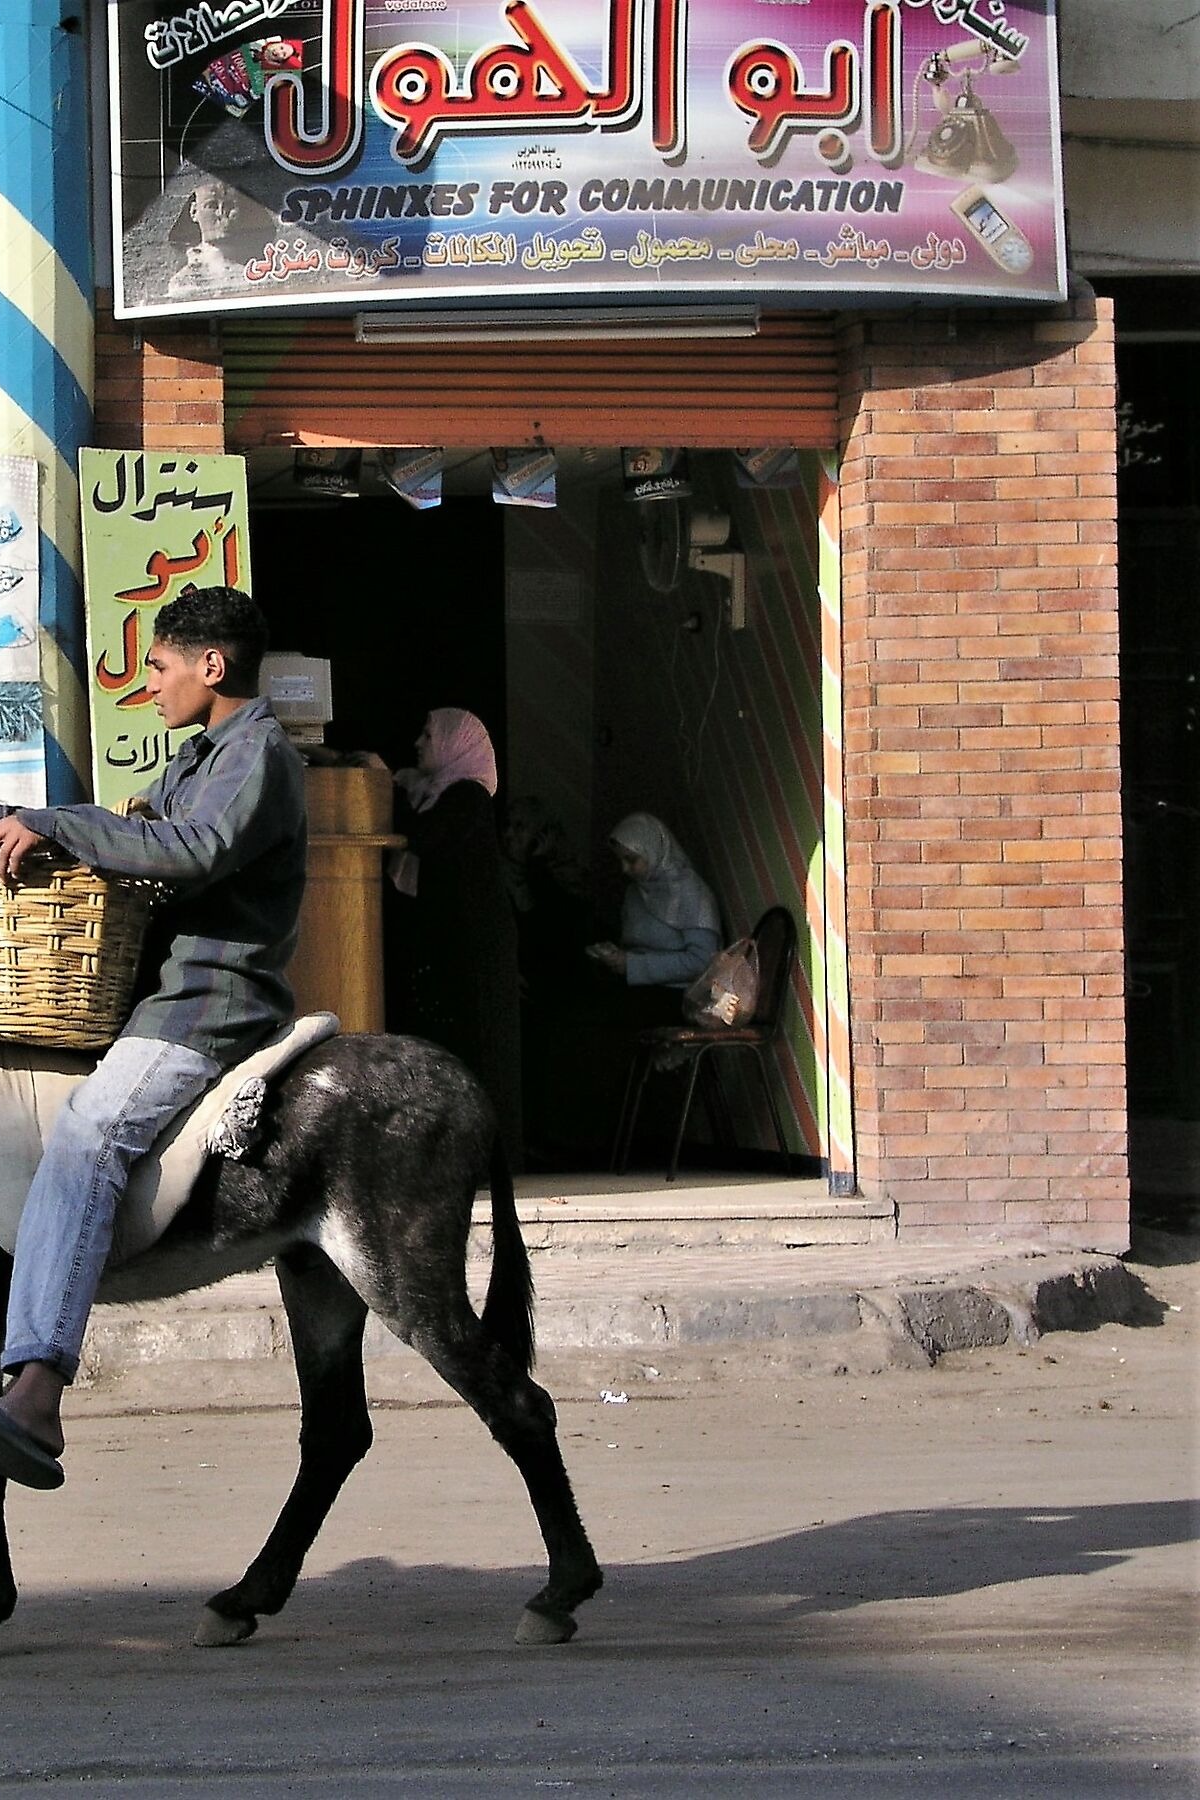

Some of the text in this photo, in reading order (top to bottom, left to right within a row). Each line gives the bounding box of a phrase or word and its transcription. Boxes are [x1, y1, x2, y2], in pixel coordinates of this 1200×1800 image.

[265, 0, 688, 175] الهول
[281, 178, 904, 225] SPHINXES FOR COMMUNICATION
[328, 238, 401, 277] كروت
[522, 227, 605, 271] تحويل
[628, 231, 712, 268] محمول
[819, 223, 891, 269] مباشر
[93, 453, 234, 521] سنترال
[113, 516, 241, 602] أبو
